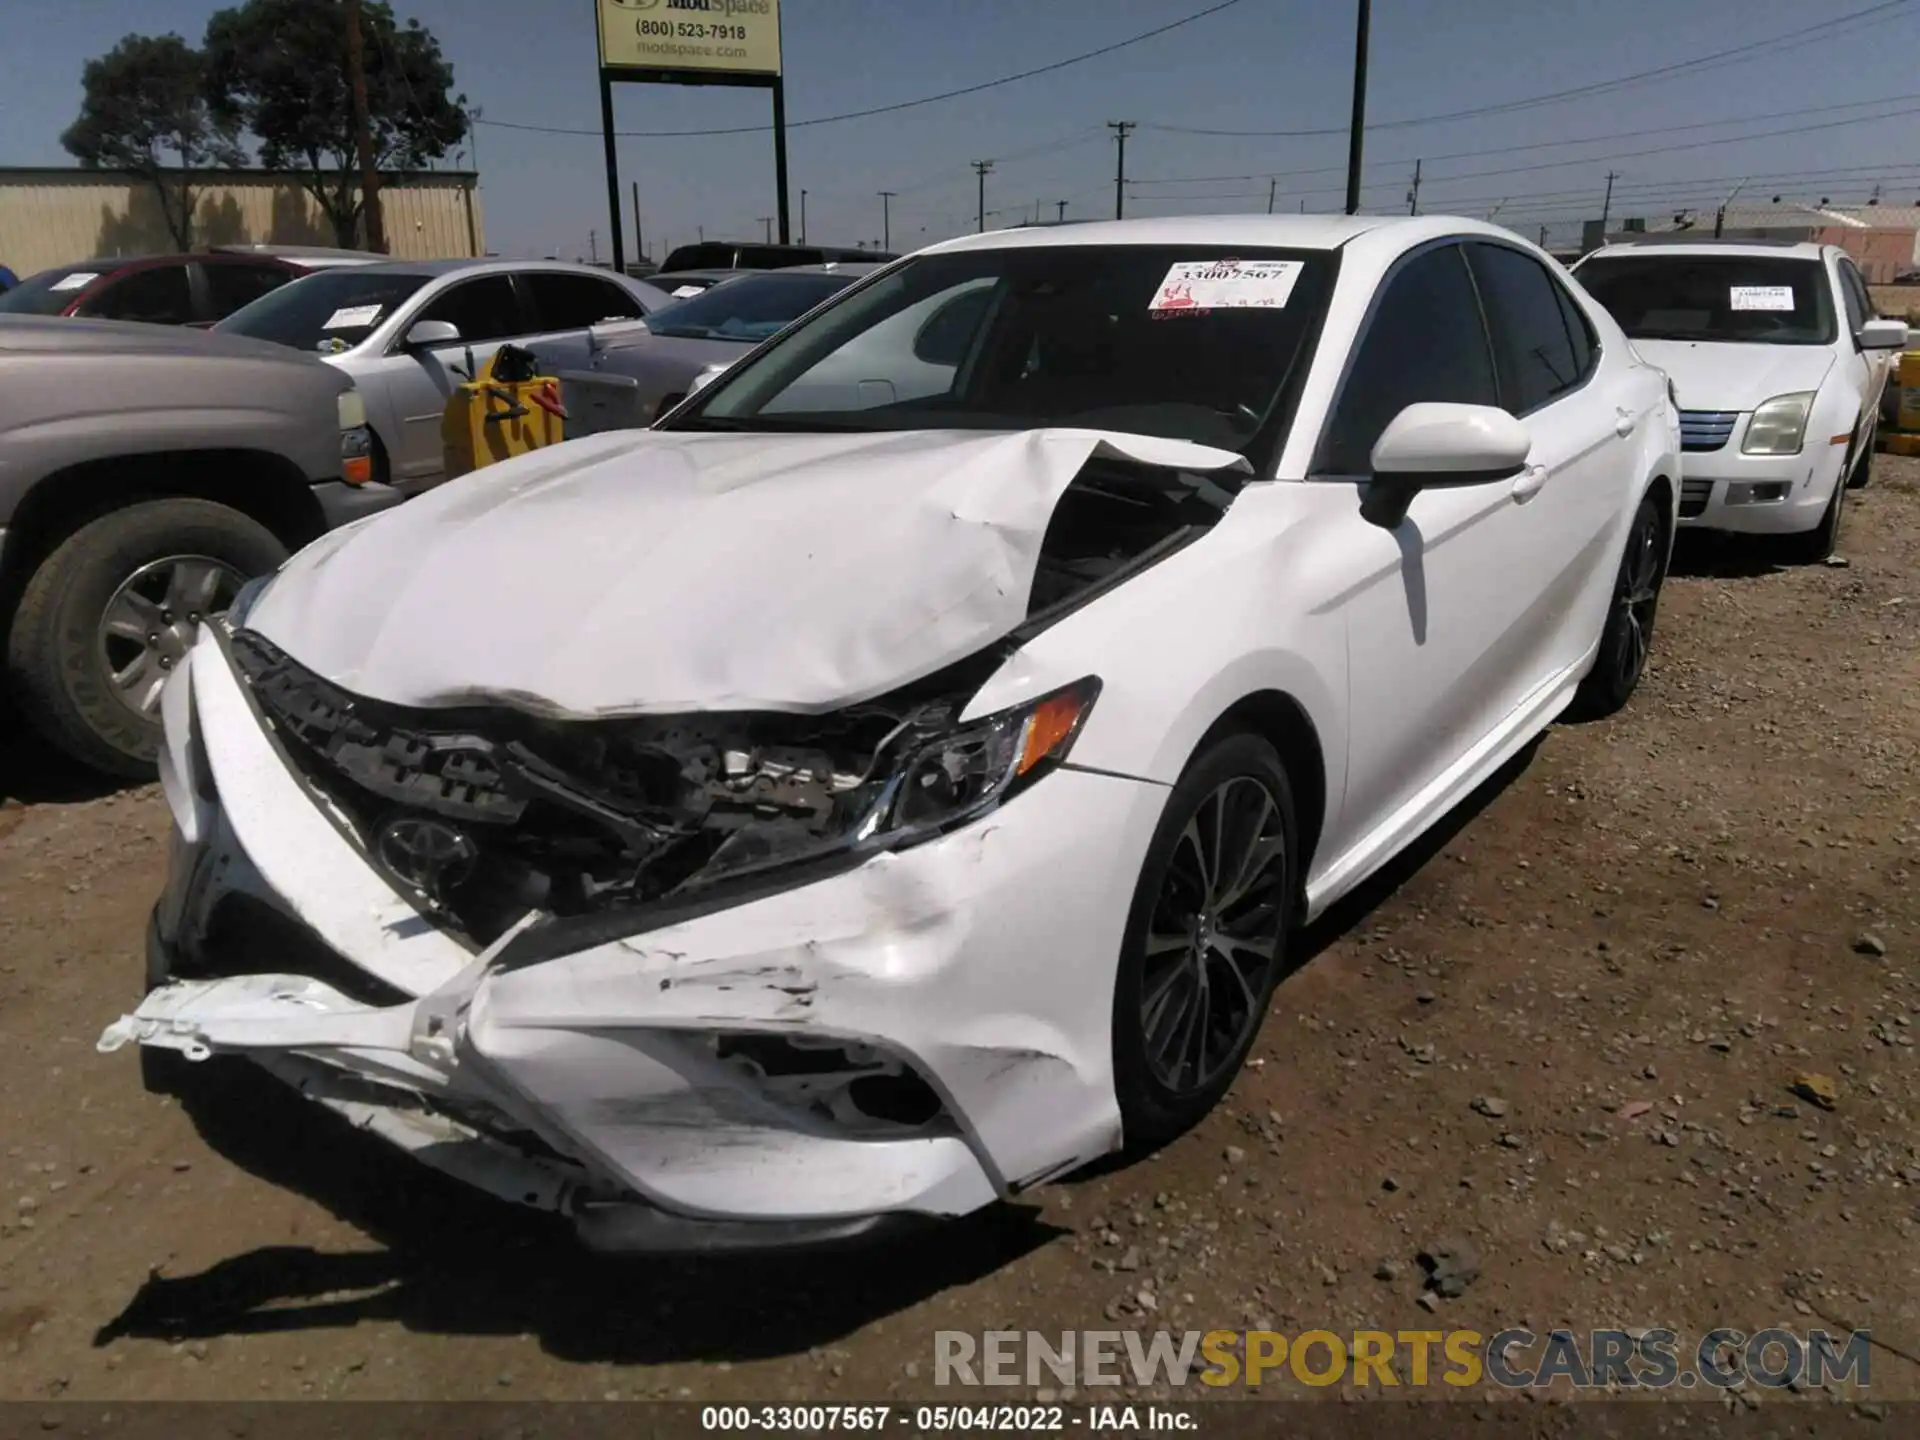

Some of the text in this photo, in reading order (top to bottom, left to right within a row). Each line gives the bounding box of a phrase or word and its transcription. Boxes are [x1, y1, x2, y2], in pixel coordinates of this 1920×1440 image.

[666, 0, 770, 16] ModSpace
[636, 19, 746, 40] (800) 523-7918
[637, 41, 747, 58] modspace.com
[1182, 269, 1283, 280] 33007567
